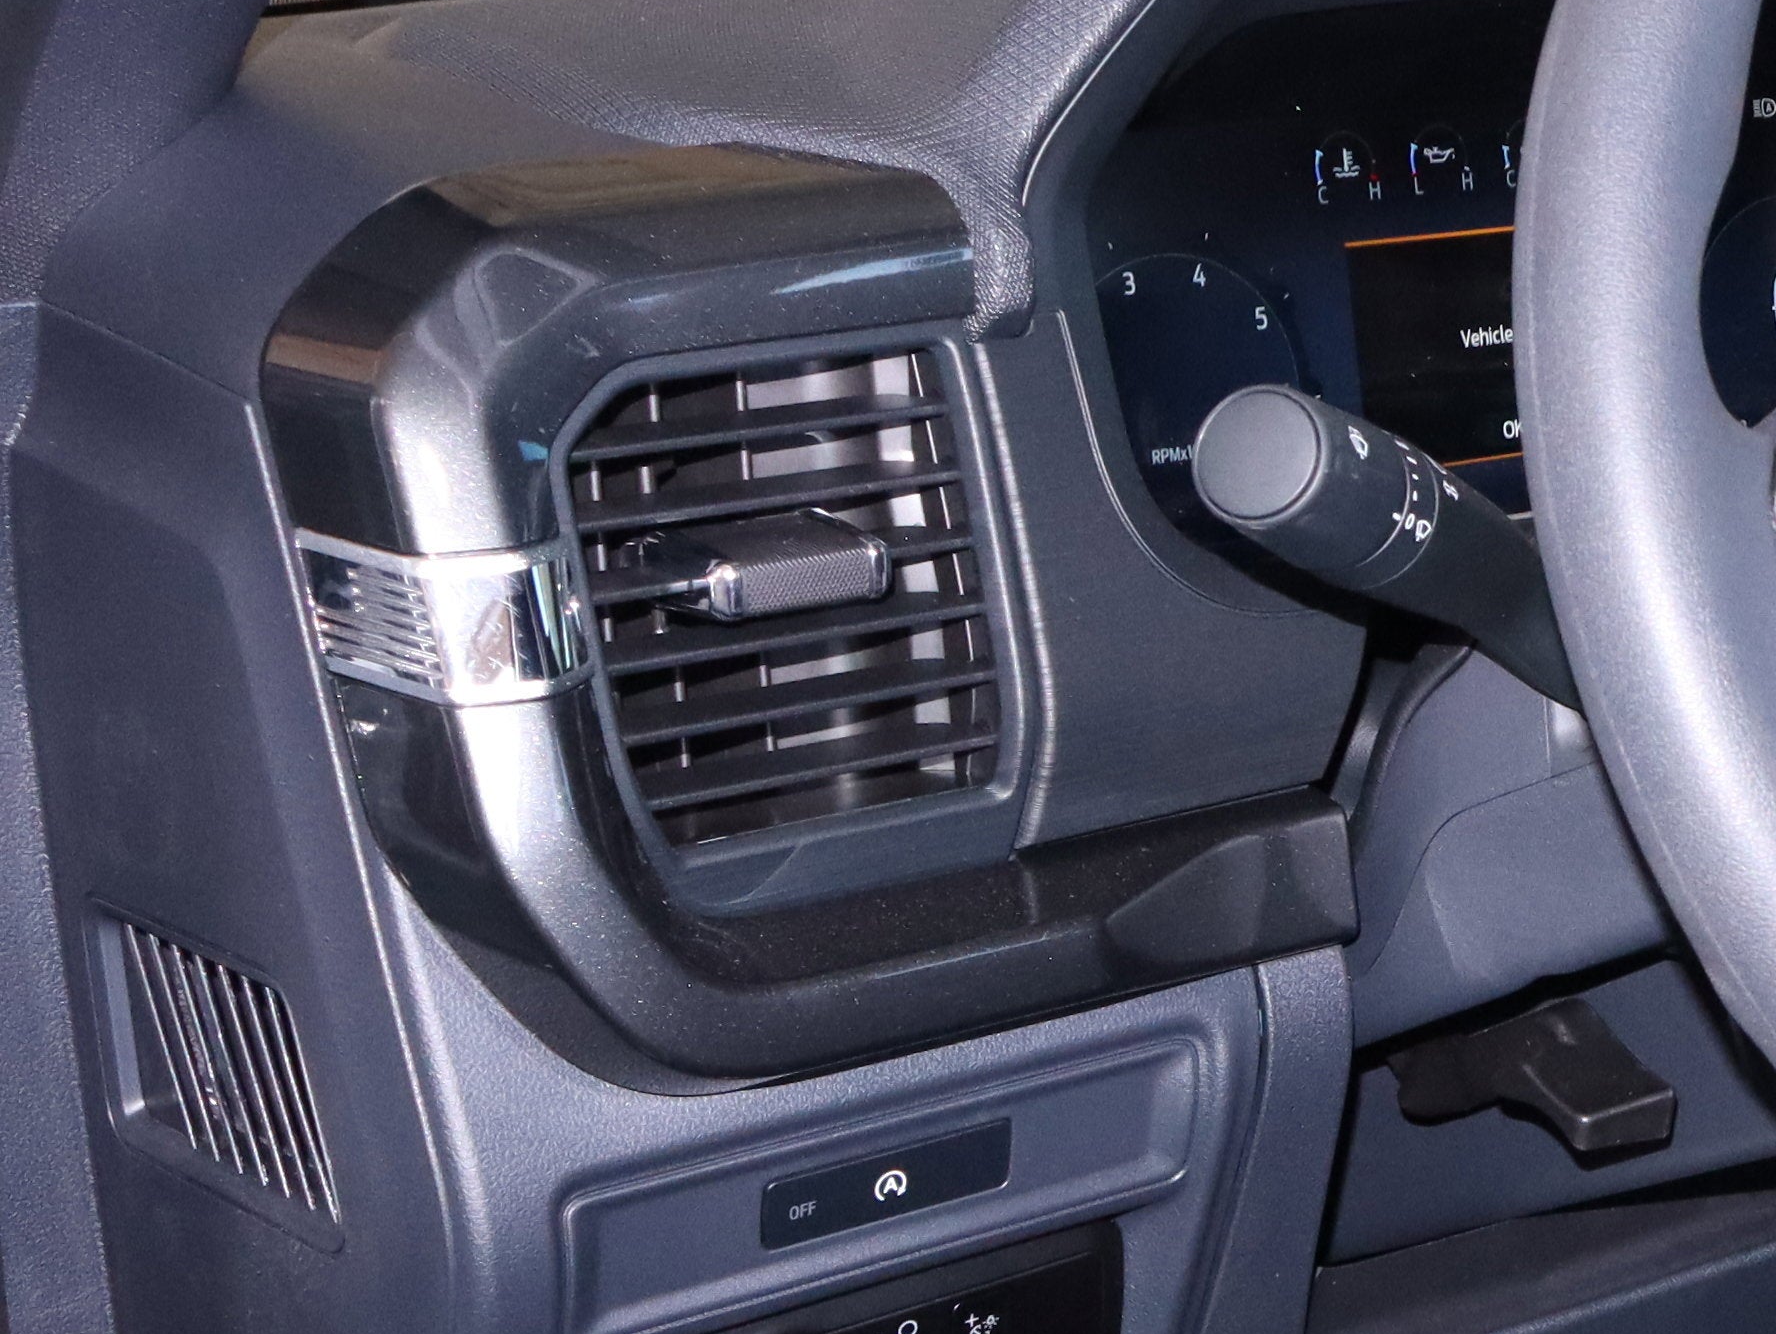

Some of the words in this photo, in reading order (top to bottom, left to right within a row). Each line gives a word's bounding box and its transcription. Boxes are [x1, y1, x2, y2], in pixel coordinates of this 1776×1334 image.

[1369, 181, 1381, 201] H
[1414, 176, 1424, 196] L
[1461, 171, 1474, 192] H
[1317, 185, 1329, 205] C
[1121, 271, 1137, 296] 3
[1192, 263, 1207, 288] 4
[1254, 306, 1269, 331] 5
[1460, 324, 1514, 348] Vehicle
[788, 1199, 818, 1221] OFF
